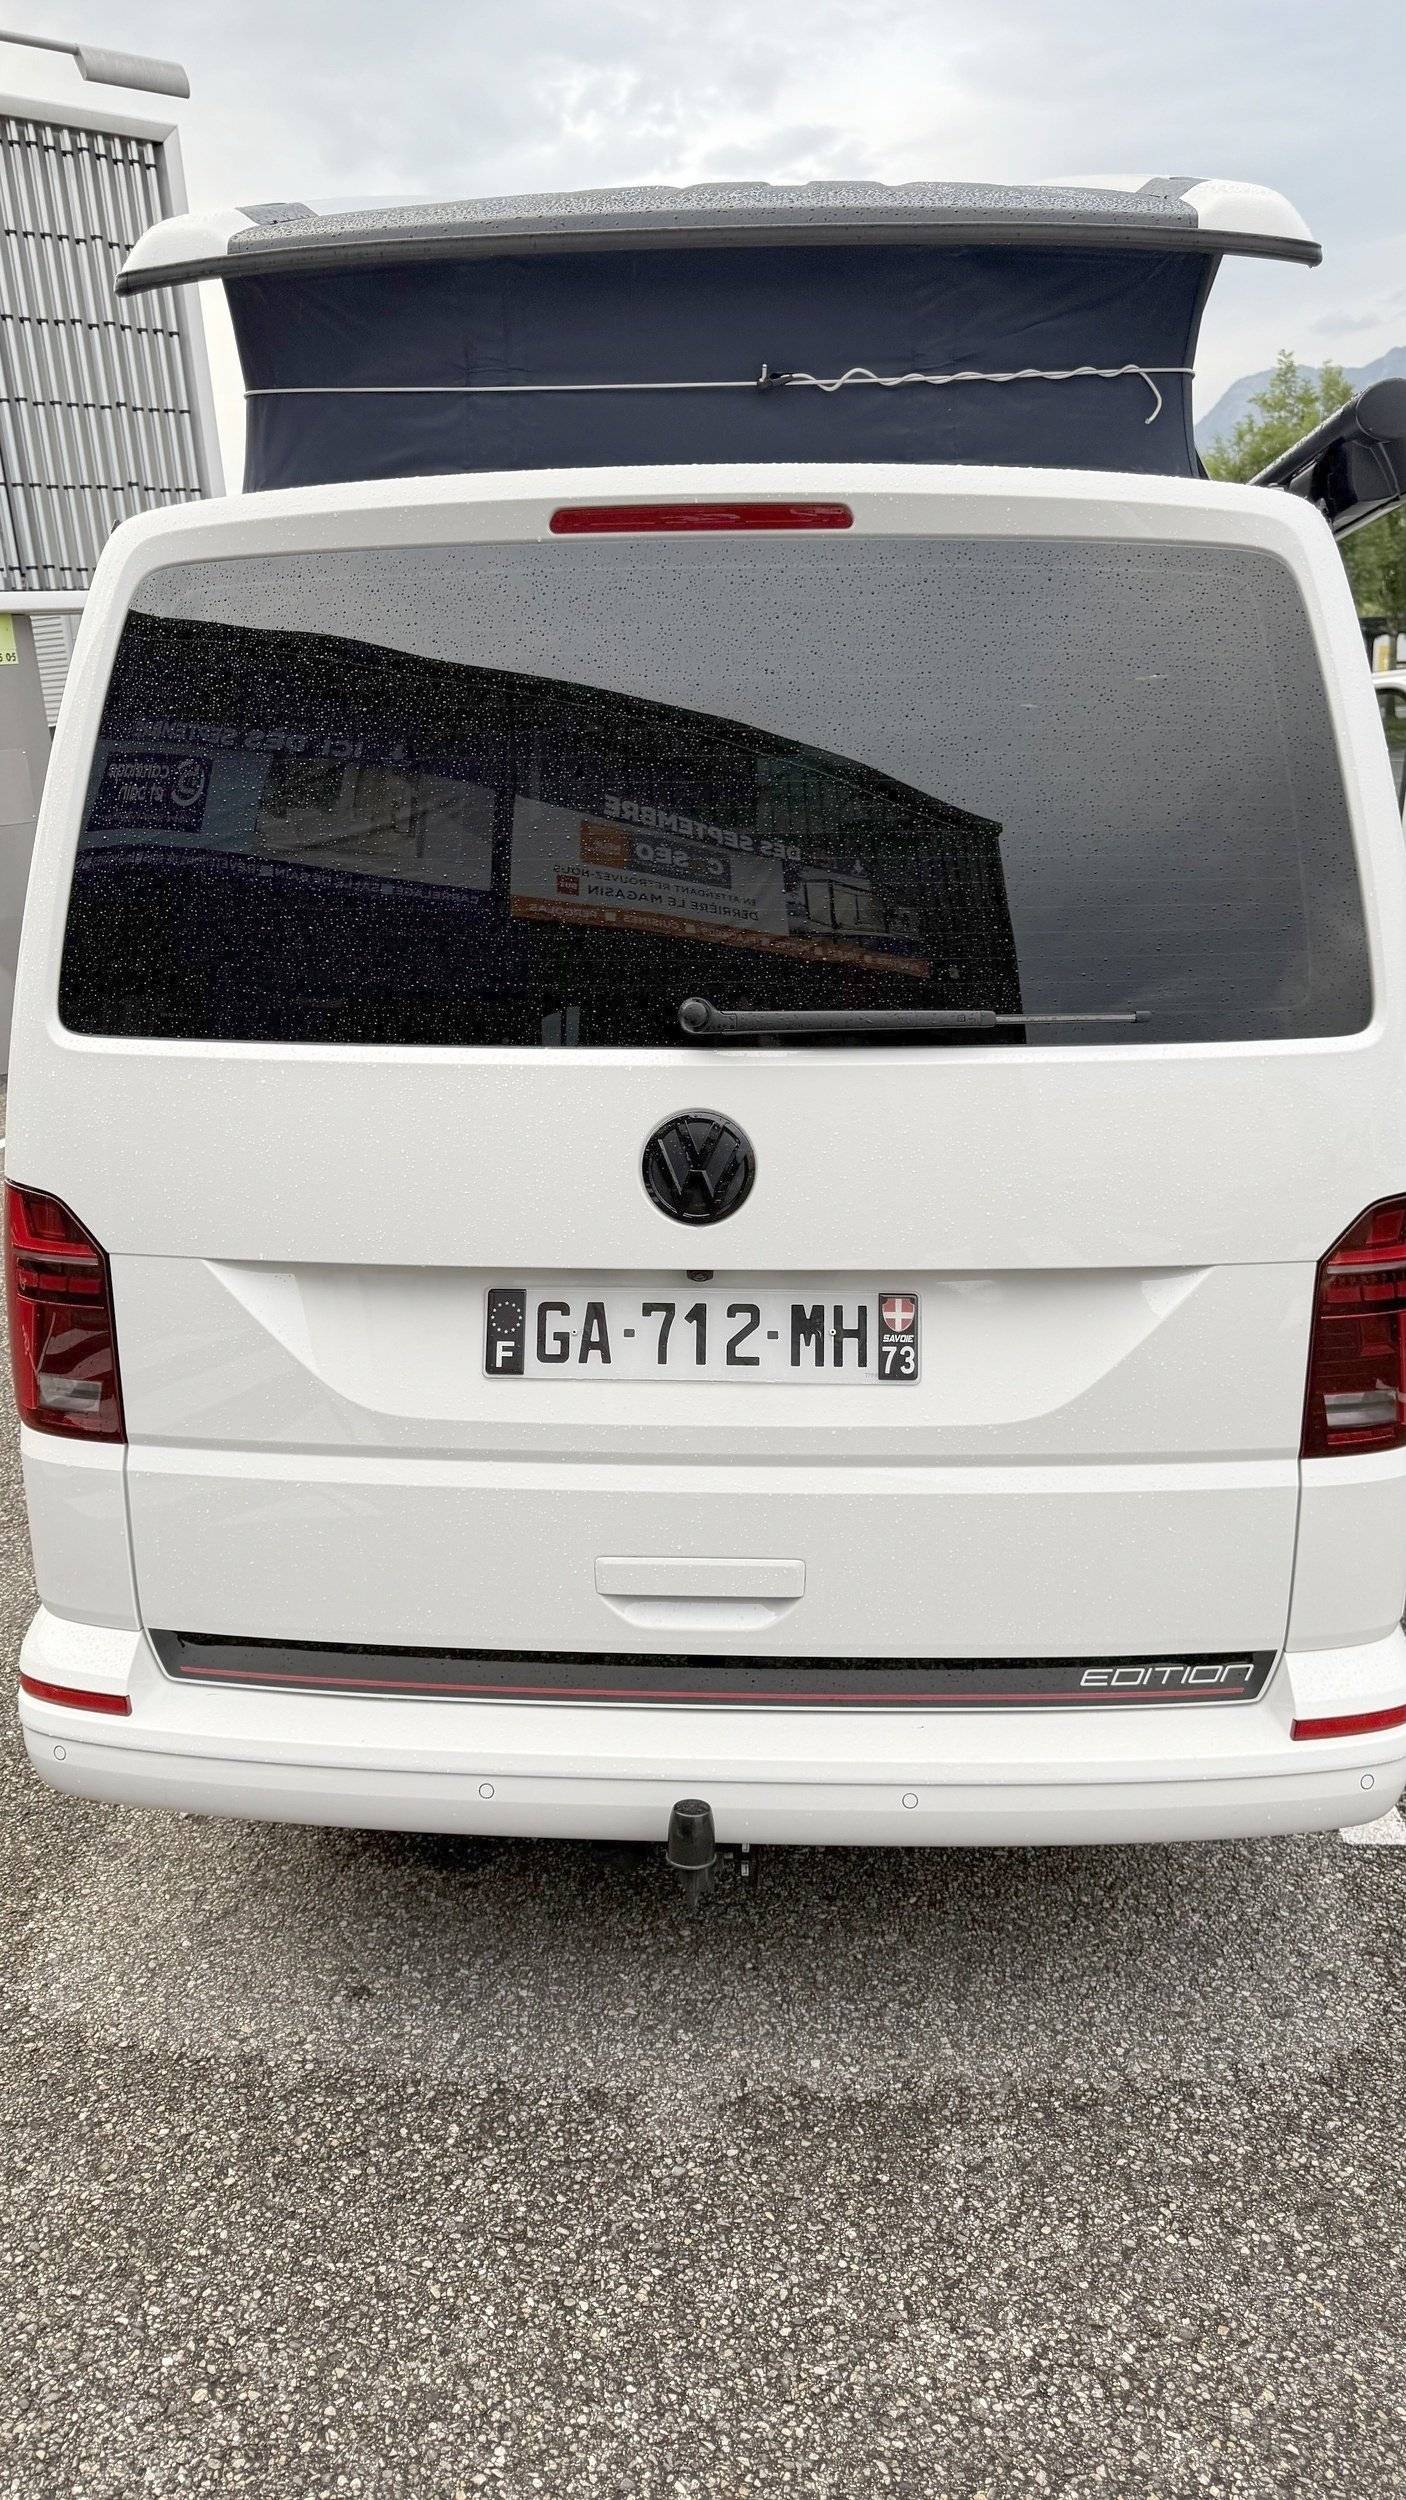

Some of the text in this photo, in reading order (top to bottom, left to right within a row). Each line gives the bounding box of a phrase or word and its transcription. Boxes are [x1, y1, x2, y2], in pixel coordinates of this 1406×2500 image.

[536, 1301, 868, 1368] GA-712-MH
[882, 1334, 915, 1343] SAVOIE
[495, 1340, 516, 1368] F
[882, 1345, 915, 1374] 73
[1079, 1663, 1255, 1687] EDITION
